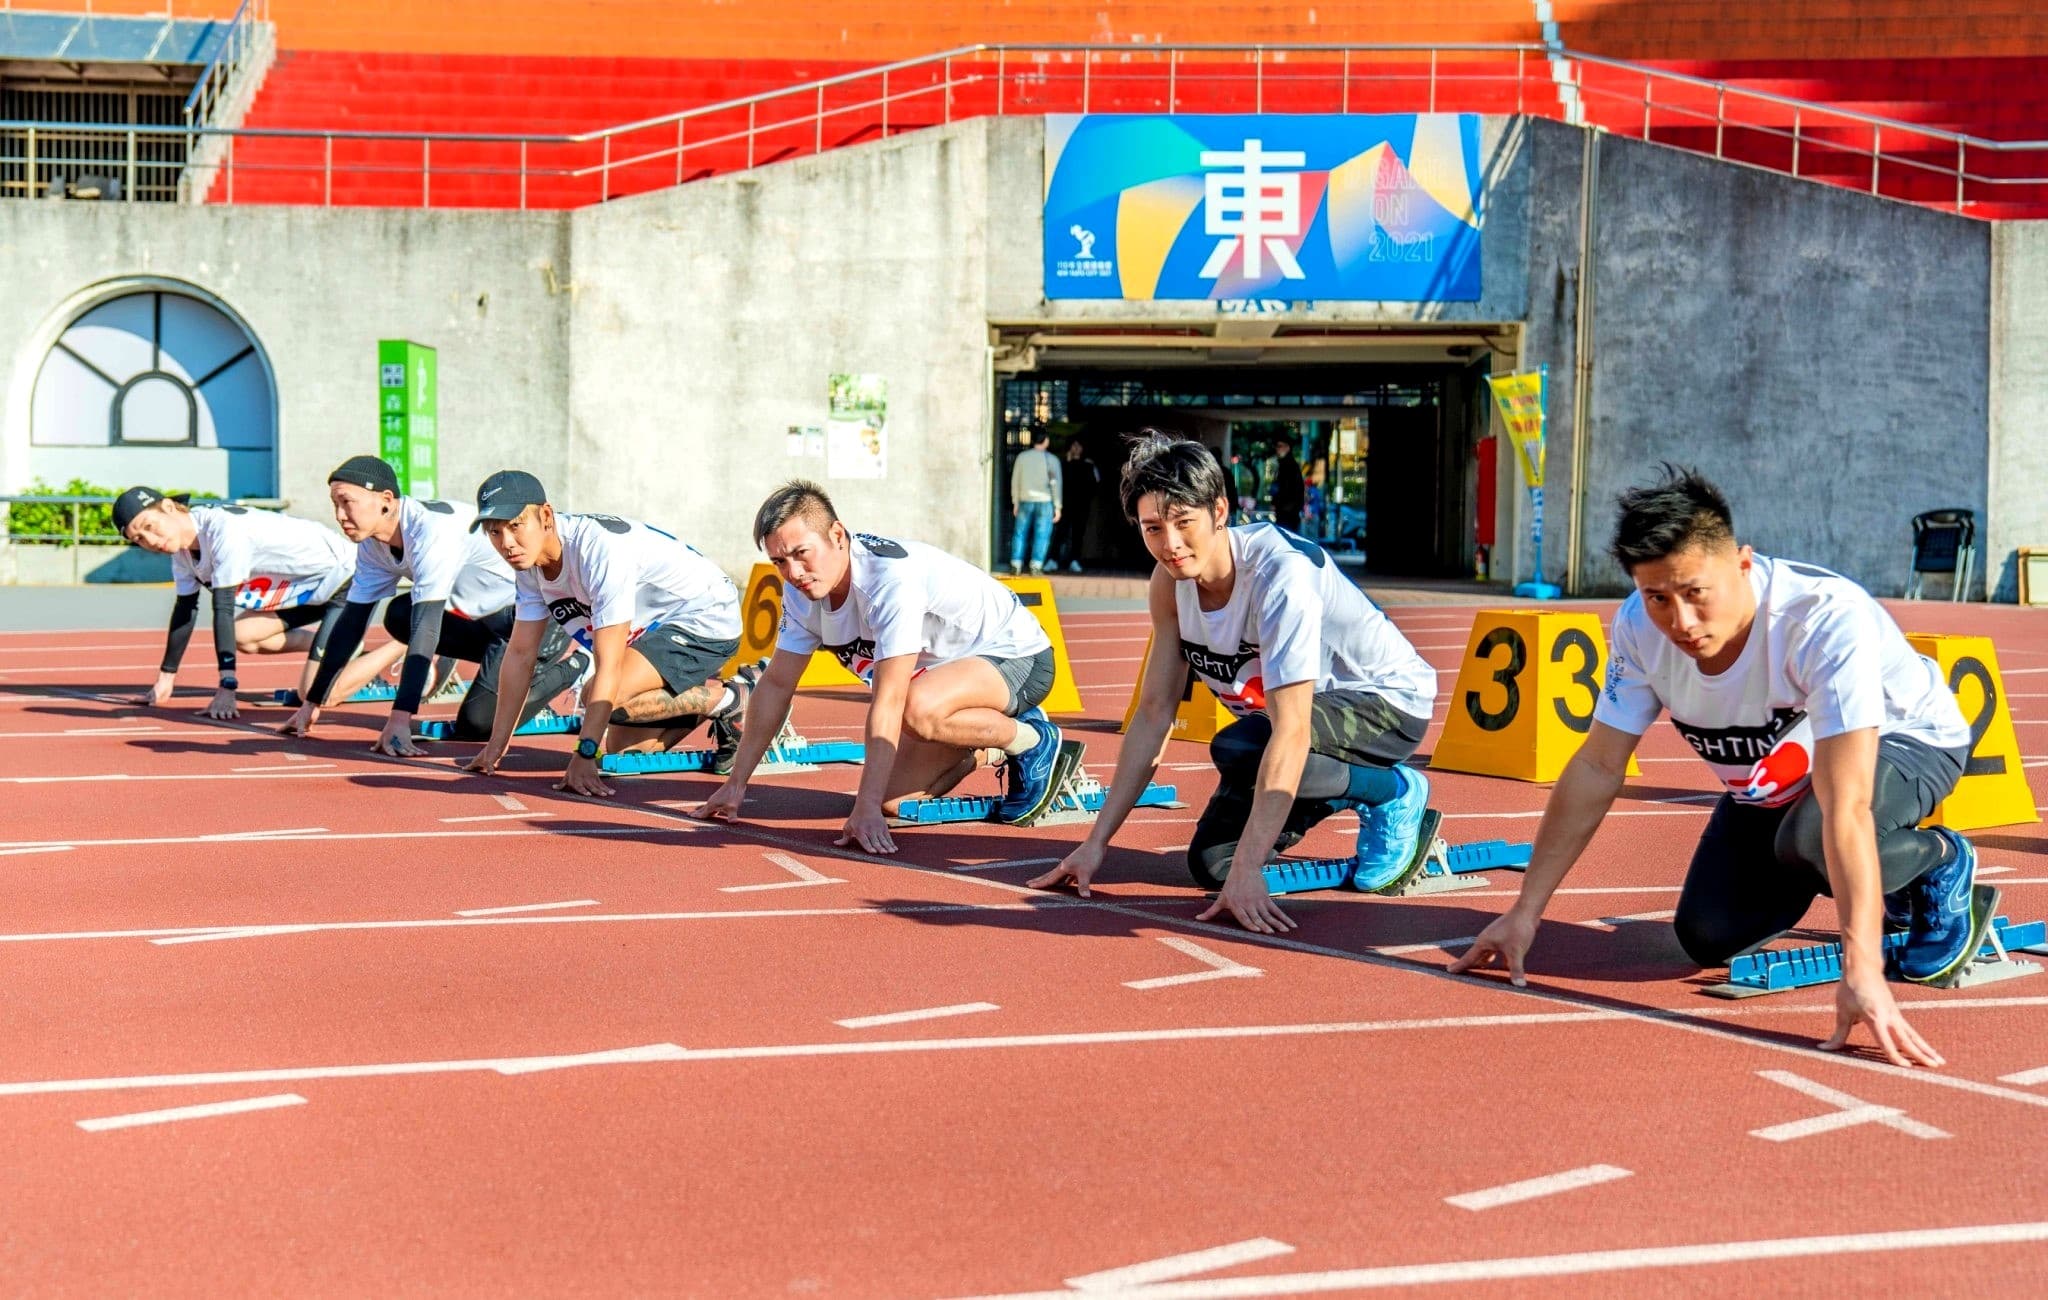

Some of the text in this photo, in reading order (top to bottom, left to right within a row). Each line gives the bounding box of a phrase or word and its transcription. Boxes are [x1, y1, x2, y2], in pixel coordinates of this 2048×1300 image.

[1199, 138, 1306, 279] 東
[1368, 231, 1433, 262] 2021
[747, 574, 783, 651] 6
[1466, 627, 1527, 732] 3
[1551, 628, 1600, 733] 3
[1949, 656, 2007, 777] 2
